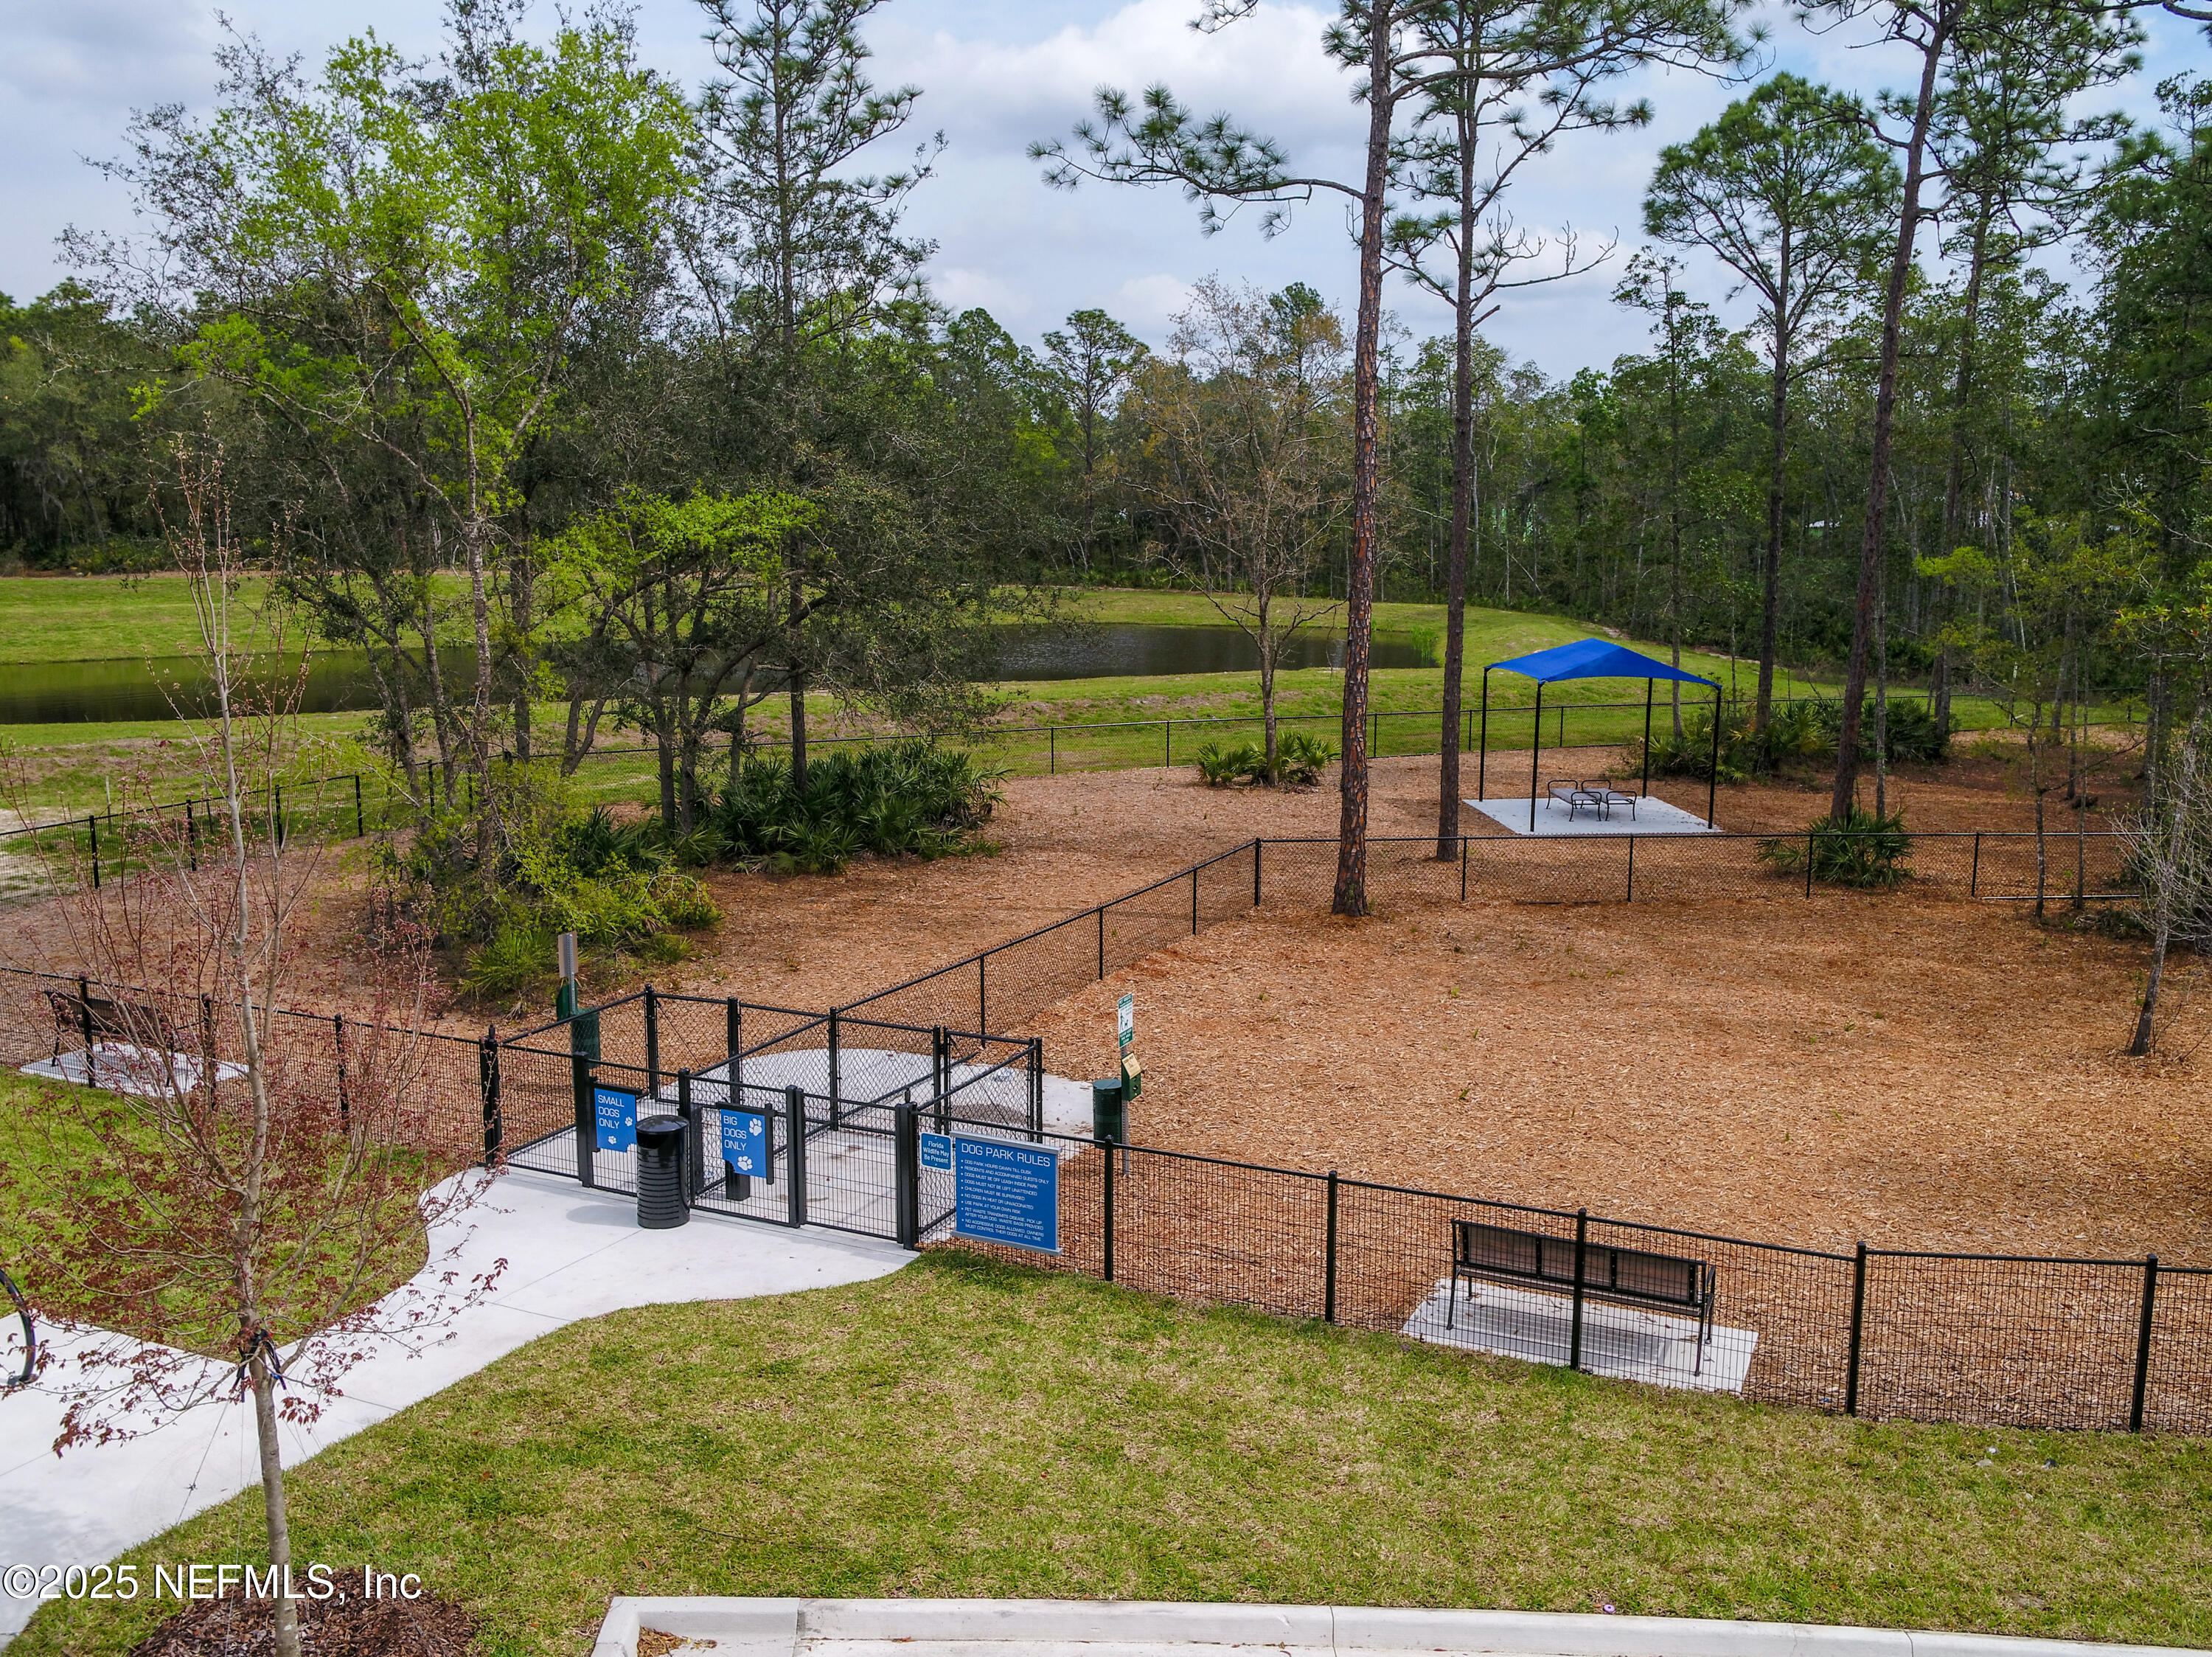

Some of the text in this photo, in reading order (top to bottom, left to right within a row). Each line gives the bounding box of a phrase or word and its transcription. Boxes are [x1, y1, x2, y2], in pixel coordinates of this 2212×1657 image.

[598, 1095, 624, 1107] SMALL
[598, 1107, 620, 1118] DOGS
[599, 1118, 619, 1129] ONLY
[724, 1115, 737, 1125] BIG
[724, 1128, 746, 1139] DOGS
[725, 1140, 746, 1151] ONLY
[928, 1141, 944, 1149] Florida
[923, 1147, 940, 1155] Wildlife
[961, 1142, 1050, 1167] DOG PARK RULES
[931, 1155, 948, 1163] Present
[994, 1171, 1022, 1179] ACCOMPANIED
[1011, 1187, 1037, 1196] UNATTENDED
[1001, 1192, 1025, 1201] SUPERVISED
[1004, 1200, 1033, 1209] UNVACCINATED
